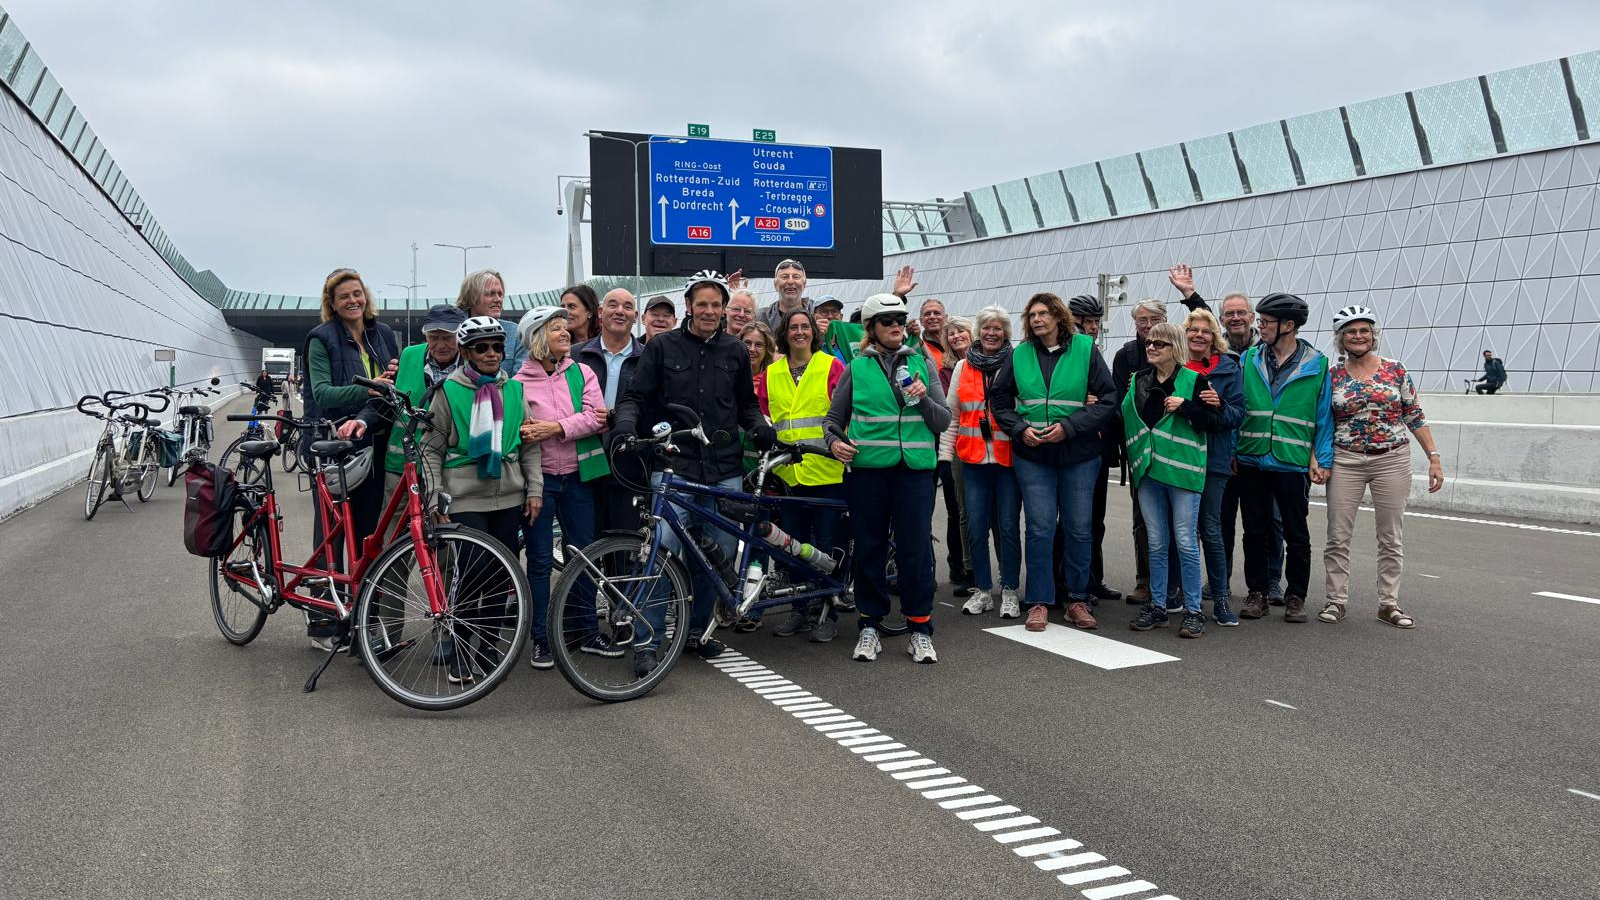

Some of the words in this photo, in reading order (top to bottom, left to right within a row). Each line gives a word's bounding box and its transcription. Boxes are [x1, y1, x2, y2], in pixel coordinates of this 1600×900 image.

[753, 148, 794, 159] Utrecht
[674, 160, 722, 170] RING-Oost
[753, 160, 785, 170] Gouda
[656, 173, 740, 186] Rotterdam-Zuid
[753, 178, 804, 189] Rotterdam
[682, 187, 715, 197] Breda
[673, 199, 724, 211] Dordrecht
[760, 234, 782, 242] 2500
